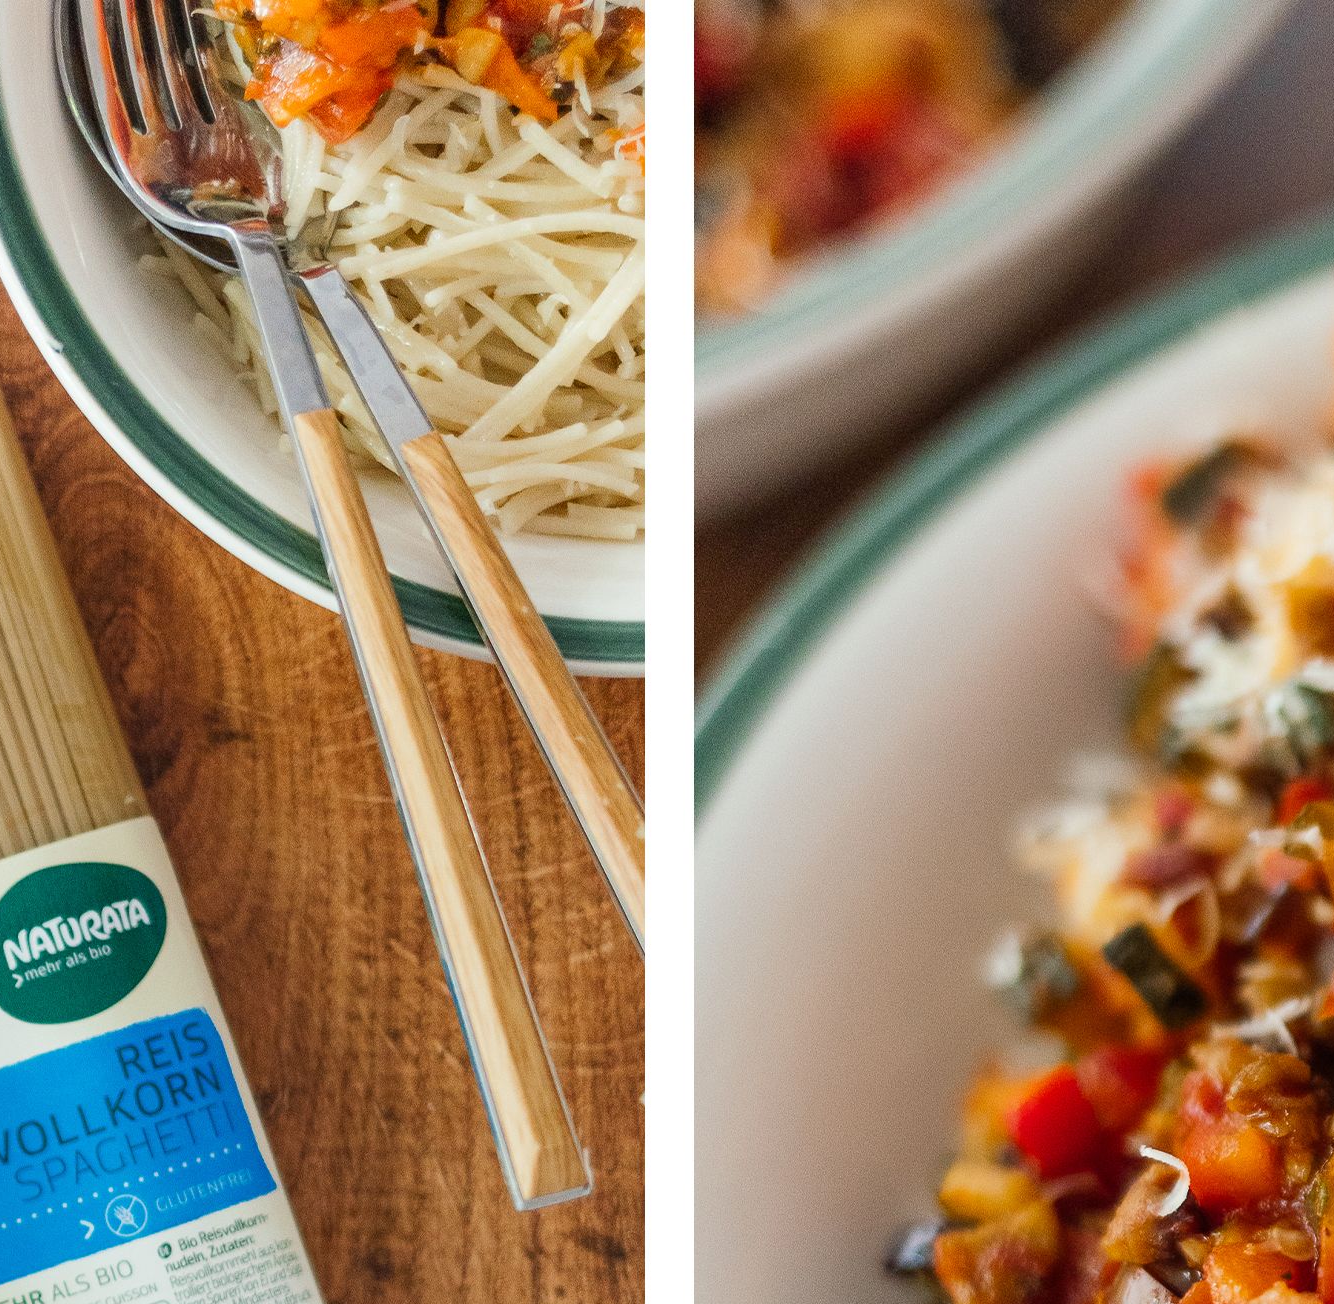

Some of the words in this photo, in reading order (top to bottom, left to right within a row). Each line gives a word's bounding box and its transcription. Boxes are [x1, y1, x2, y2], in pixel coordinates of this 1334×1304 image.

[23, 958, 64, 982] mehr
[63, 950, 88, 968] als
[88, 942, 113, 961] bio
[114, 1019, 211, 1080] REIS
[11, 1099, 237, 1204] SPAGHETTI
[153, 1167, 254, 1213] GLUTENFREI
[48, 1272, 91, 1301] ALS
[94, 1258, 134, 1286] BIO
